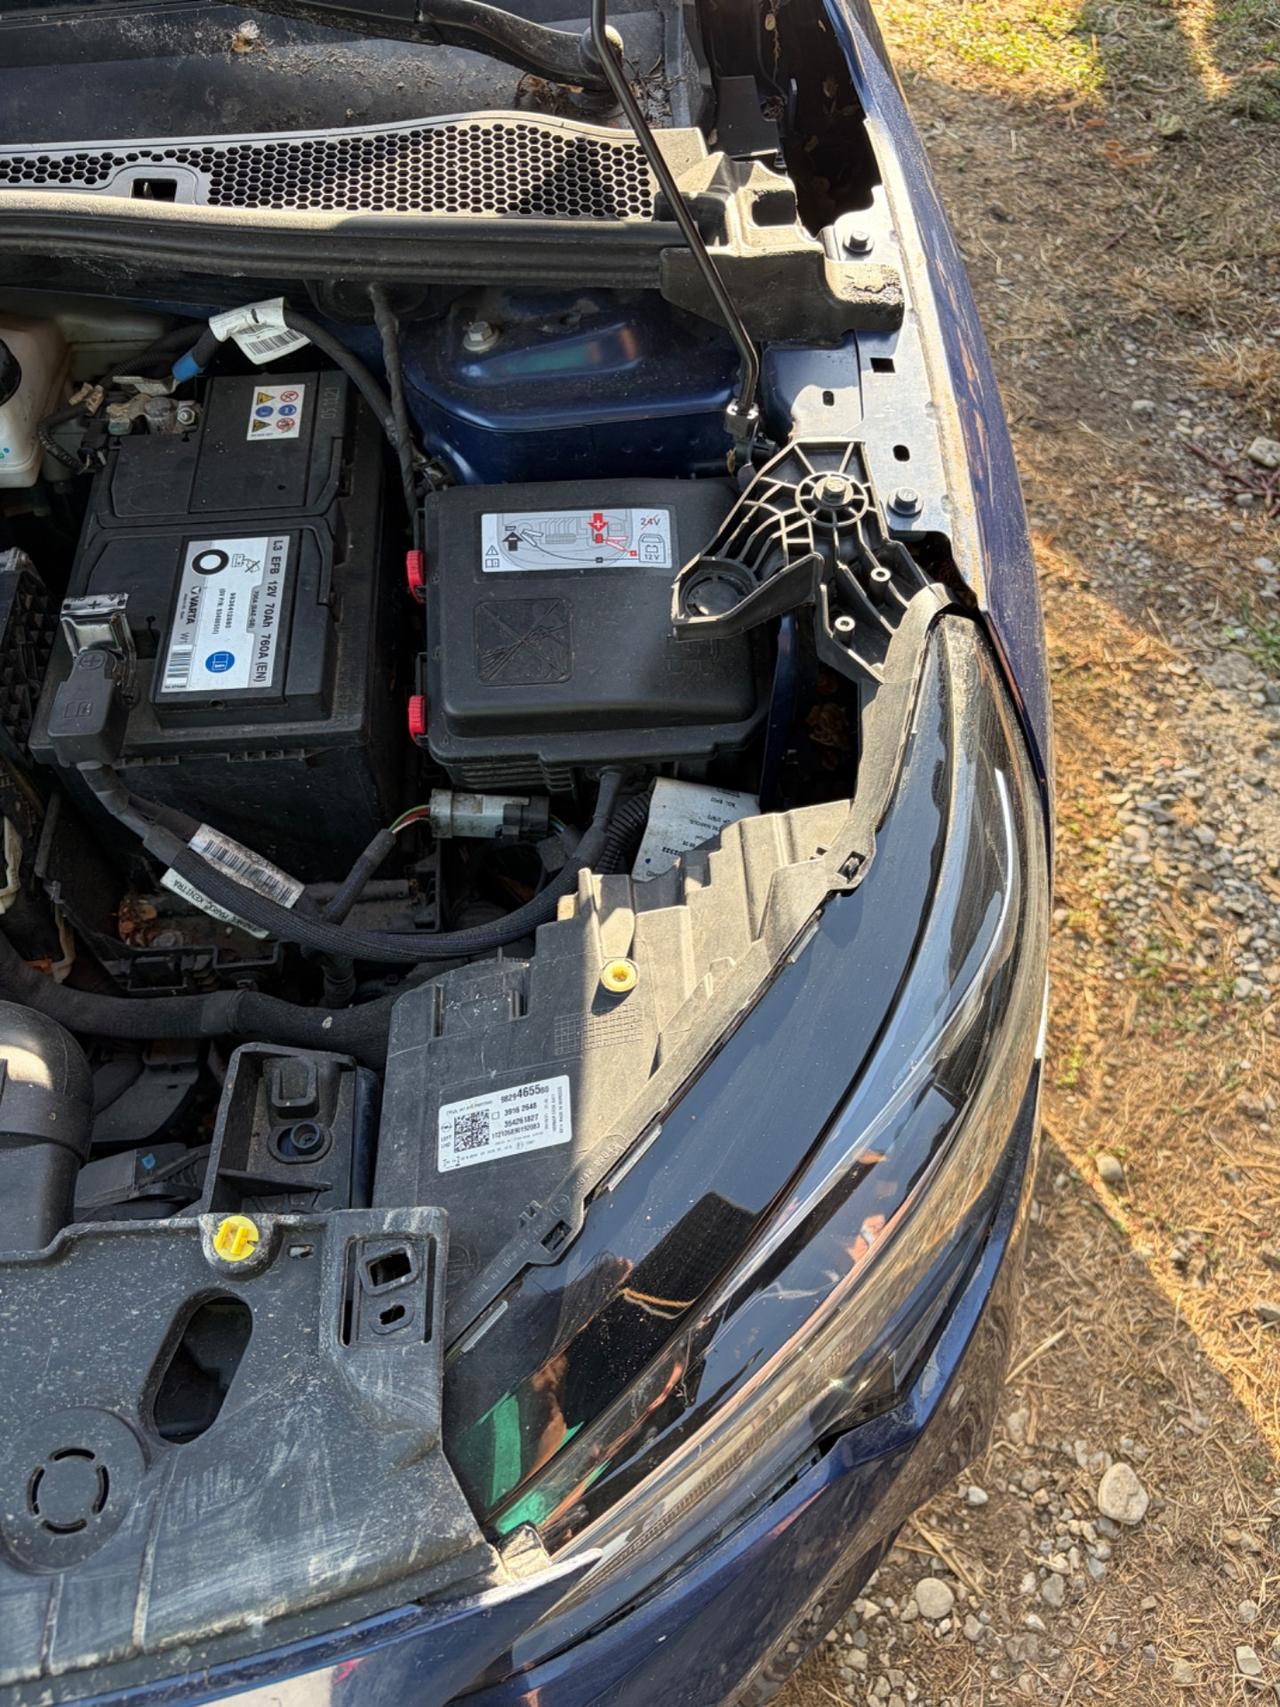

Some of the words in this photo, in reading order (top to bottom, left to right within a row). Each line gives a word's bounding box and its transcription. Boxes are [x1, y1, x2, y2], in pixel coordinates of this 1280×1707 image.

[640, 517, 661, 526] 24V
[273, 540, 284, 552] L3
[269, 556, 281, 574] EFB
[265, 581, 278, 598] 12V
[186, 595, 201, 625] VARTA
[262, 603, 275, 628] 70Ah
[258, 634, 271, 659] 760A
[253, 662, 268, 683] (EN)
[173, 879, 204, 905] KENITRA
